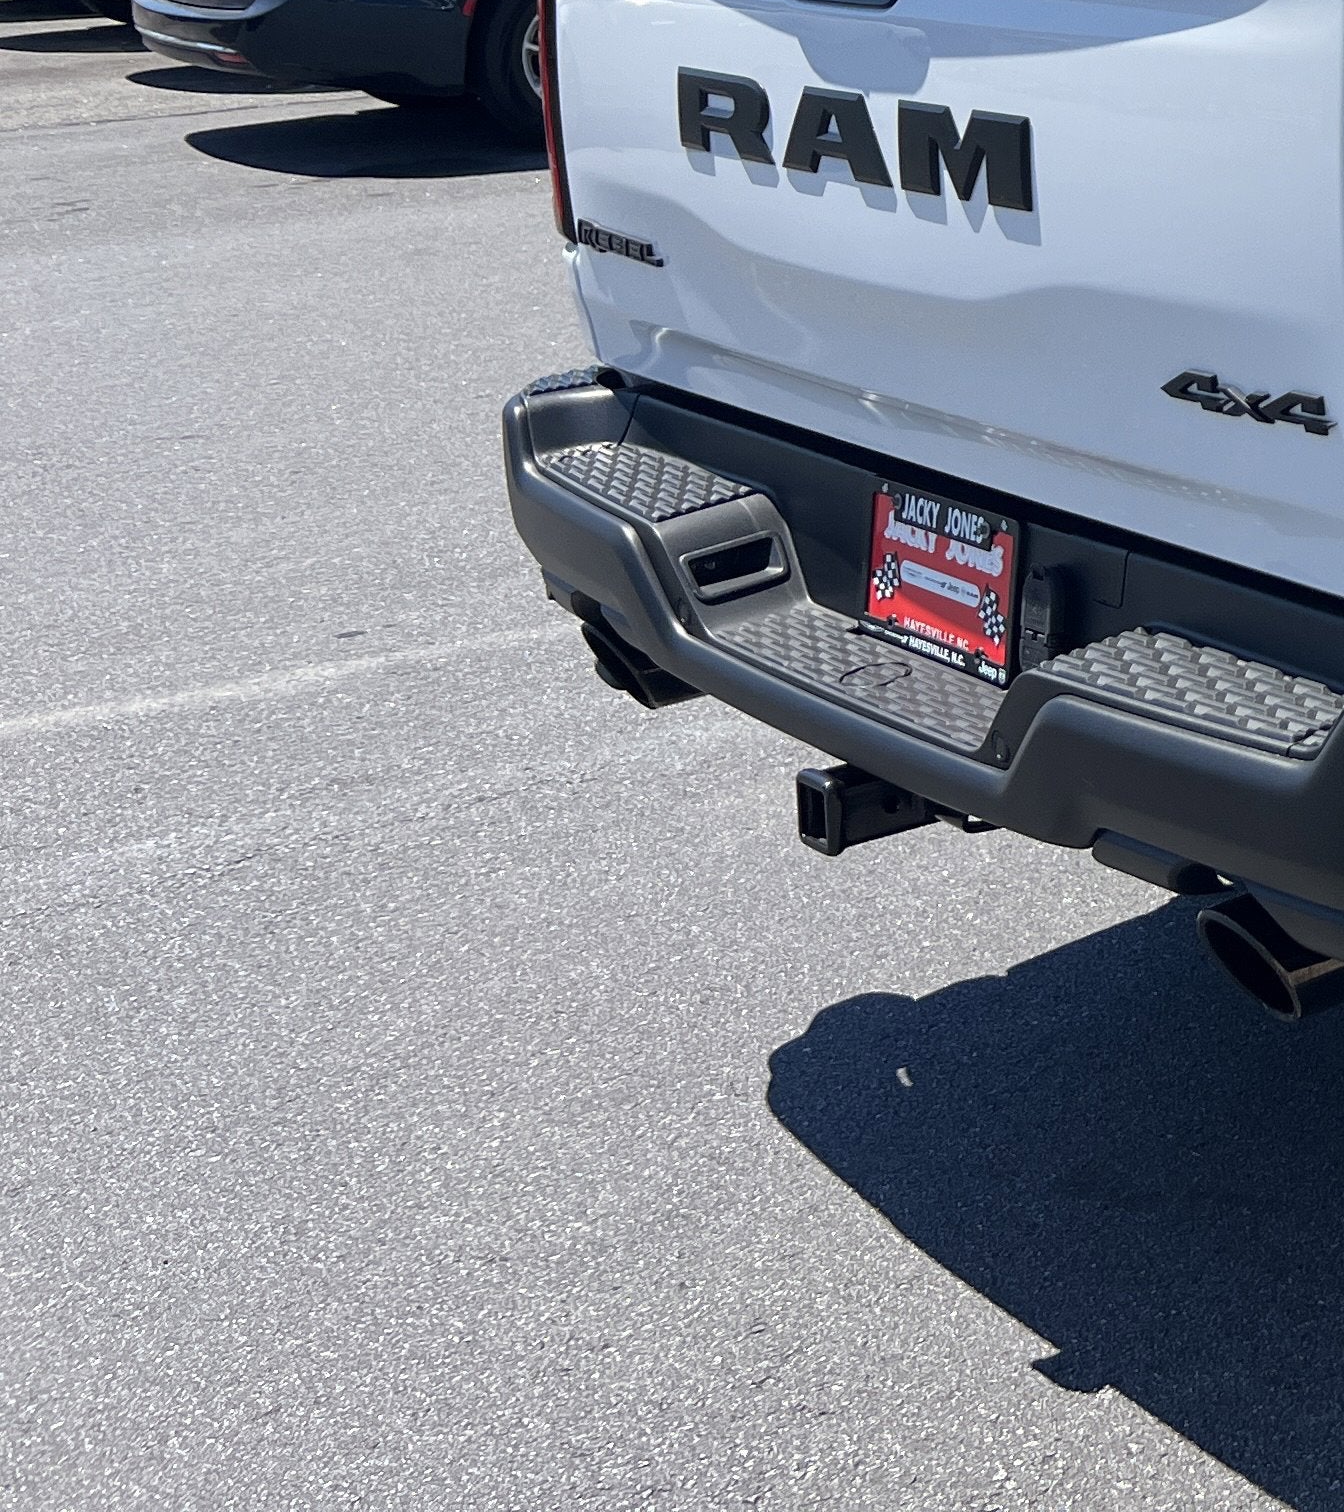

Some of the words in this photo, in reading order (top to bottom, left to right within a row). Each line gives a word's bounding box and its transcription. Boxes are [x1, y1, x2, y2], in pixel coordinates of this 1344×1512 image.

[677, 66, 1033, 212] RAM
[577, 218, 664, 268] REBEL
[902, 493, 941, 529] JACKY
[944, 507, 985, 544] JONES
[978, 660, 998, 680] Jeep
